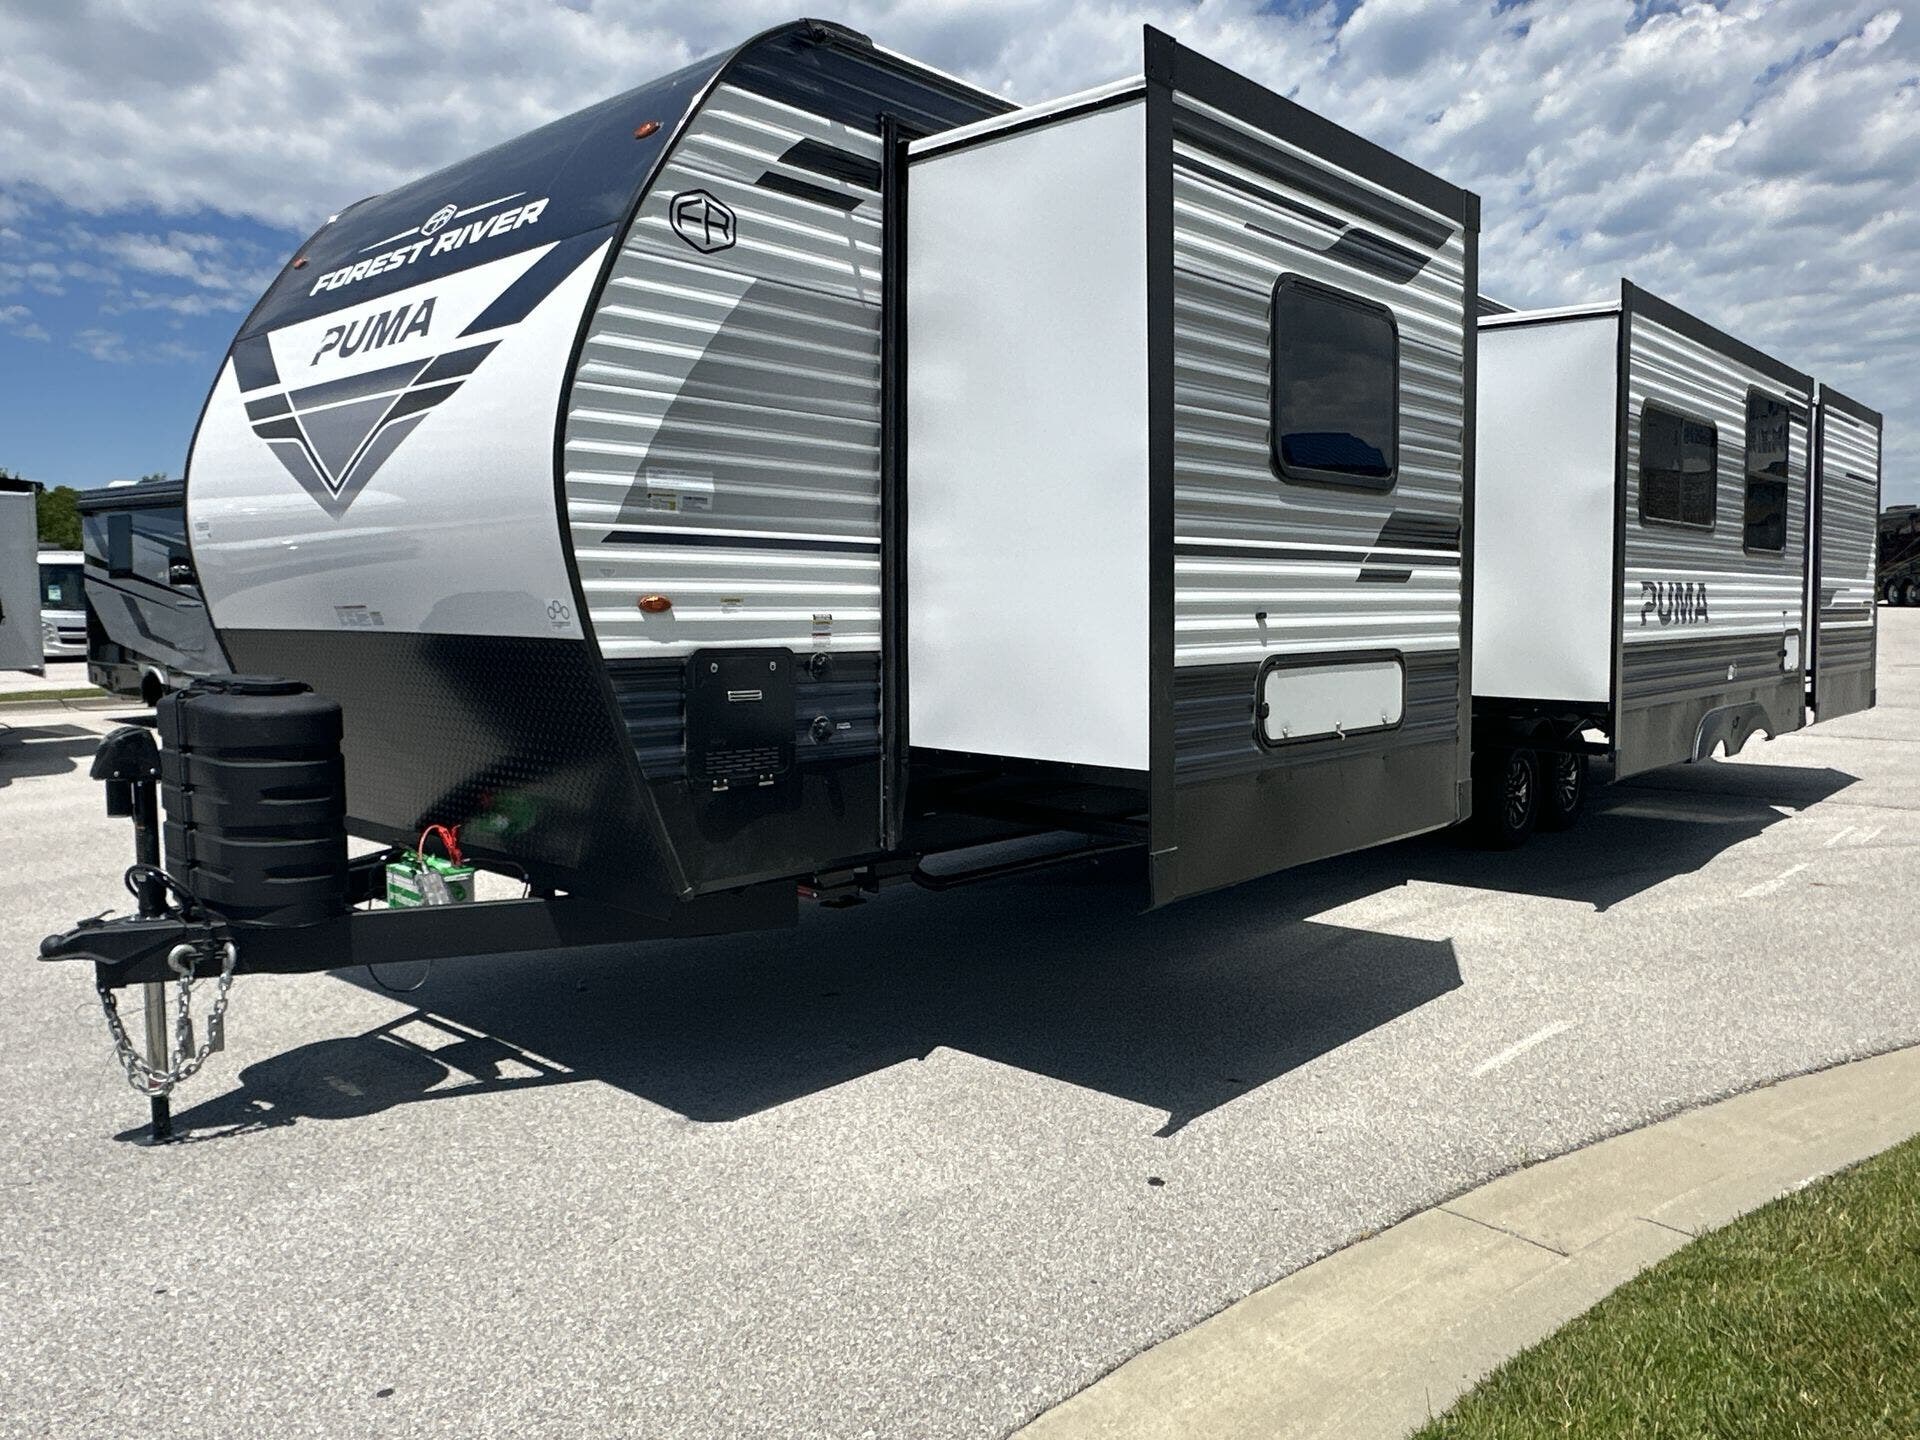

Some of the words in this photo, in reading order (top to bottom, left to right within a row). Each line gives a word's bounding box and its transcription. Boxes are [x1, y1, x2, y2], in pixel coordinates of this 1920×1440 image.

[309, 238, 433, 297] FOREST
[430, 197, 550, 257] RIVER
[310, 296, 439, 367] PUMA
[1640, 581, 1709, 627] PUMA
